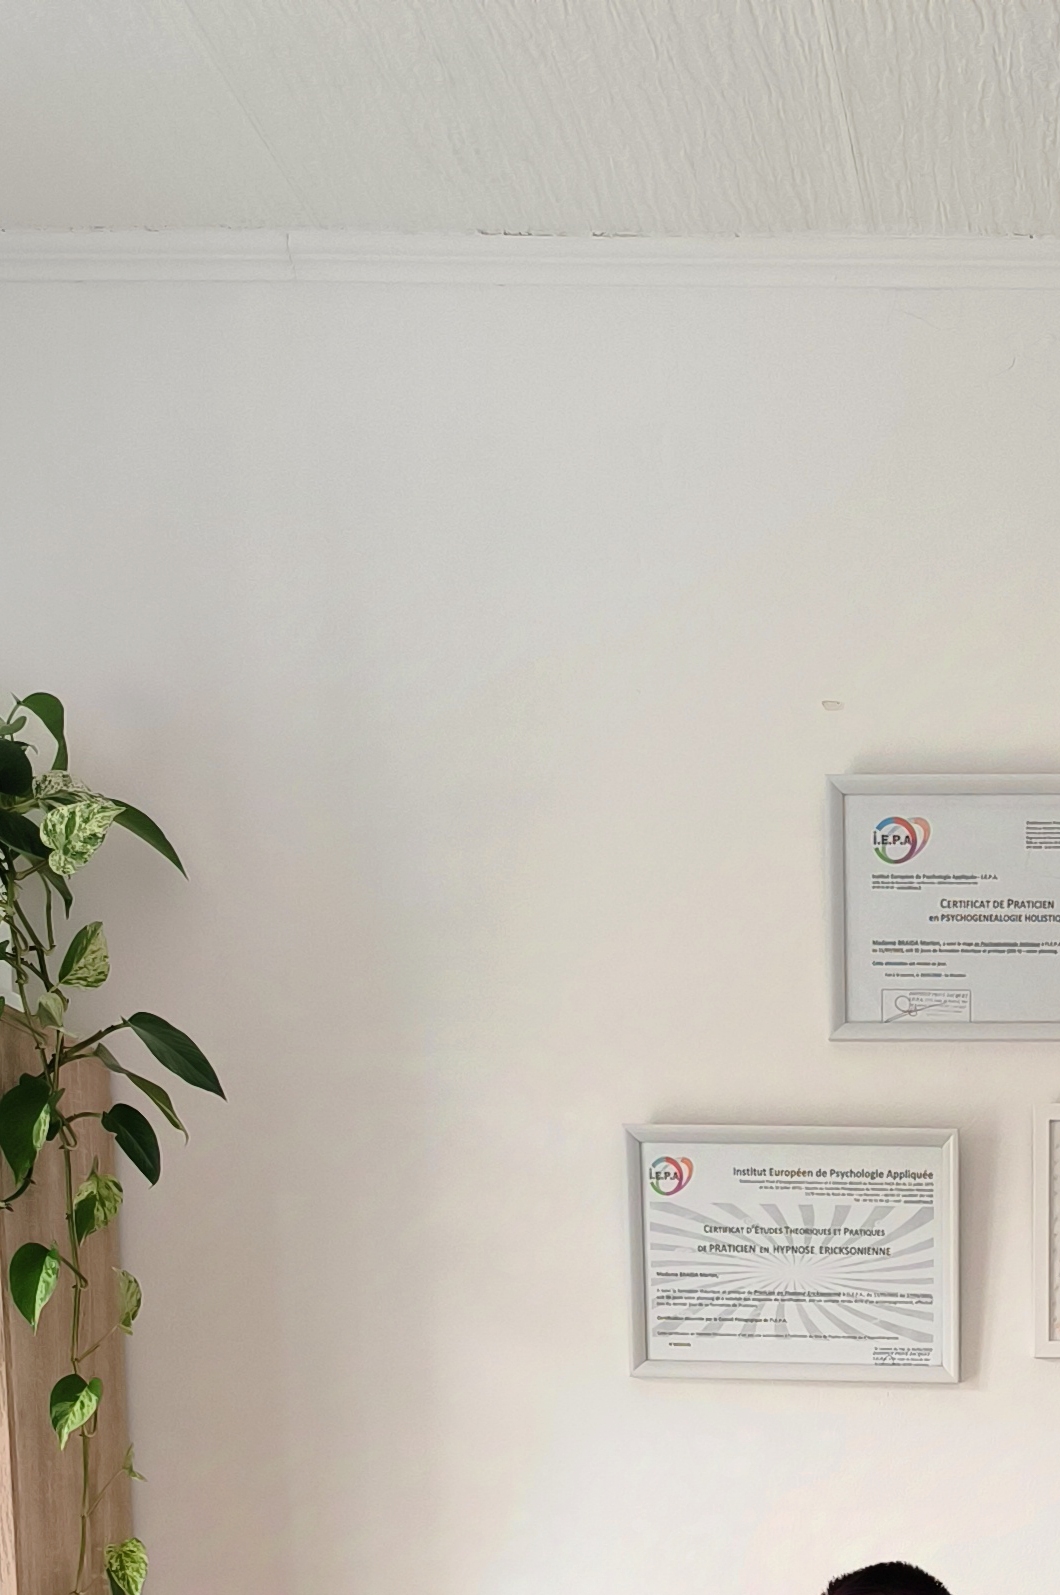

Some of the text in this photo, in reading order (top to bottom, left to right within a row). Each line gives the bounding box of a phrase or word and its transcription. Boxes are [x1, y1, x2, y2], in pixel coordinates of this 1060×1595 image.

[940, 898, 1055, 909] CERTIFICAT DE PRATICIEN
[929, 914, 939, 922] en
[733, 1167, 934, 1181] Institut Européen de Psychologie Appliquée
[703, 1224, 744, 1234] CERTIFICAT
[833, 1227, 841, 1236] ET
[843, 1227, 885, 1237] PRATIQUES
[709, 1244, 756, 1253] PRATICIEN
[773, 1245, 815, 1254] HYPNOSE
[819, 1246, 892, 1255] ERICKSONIENNE
